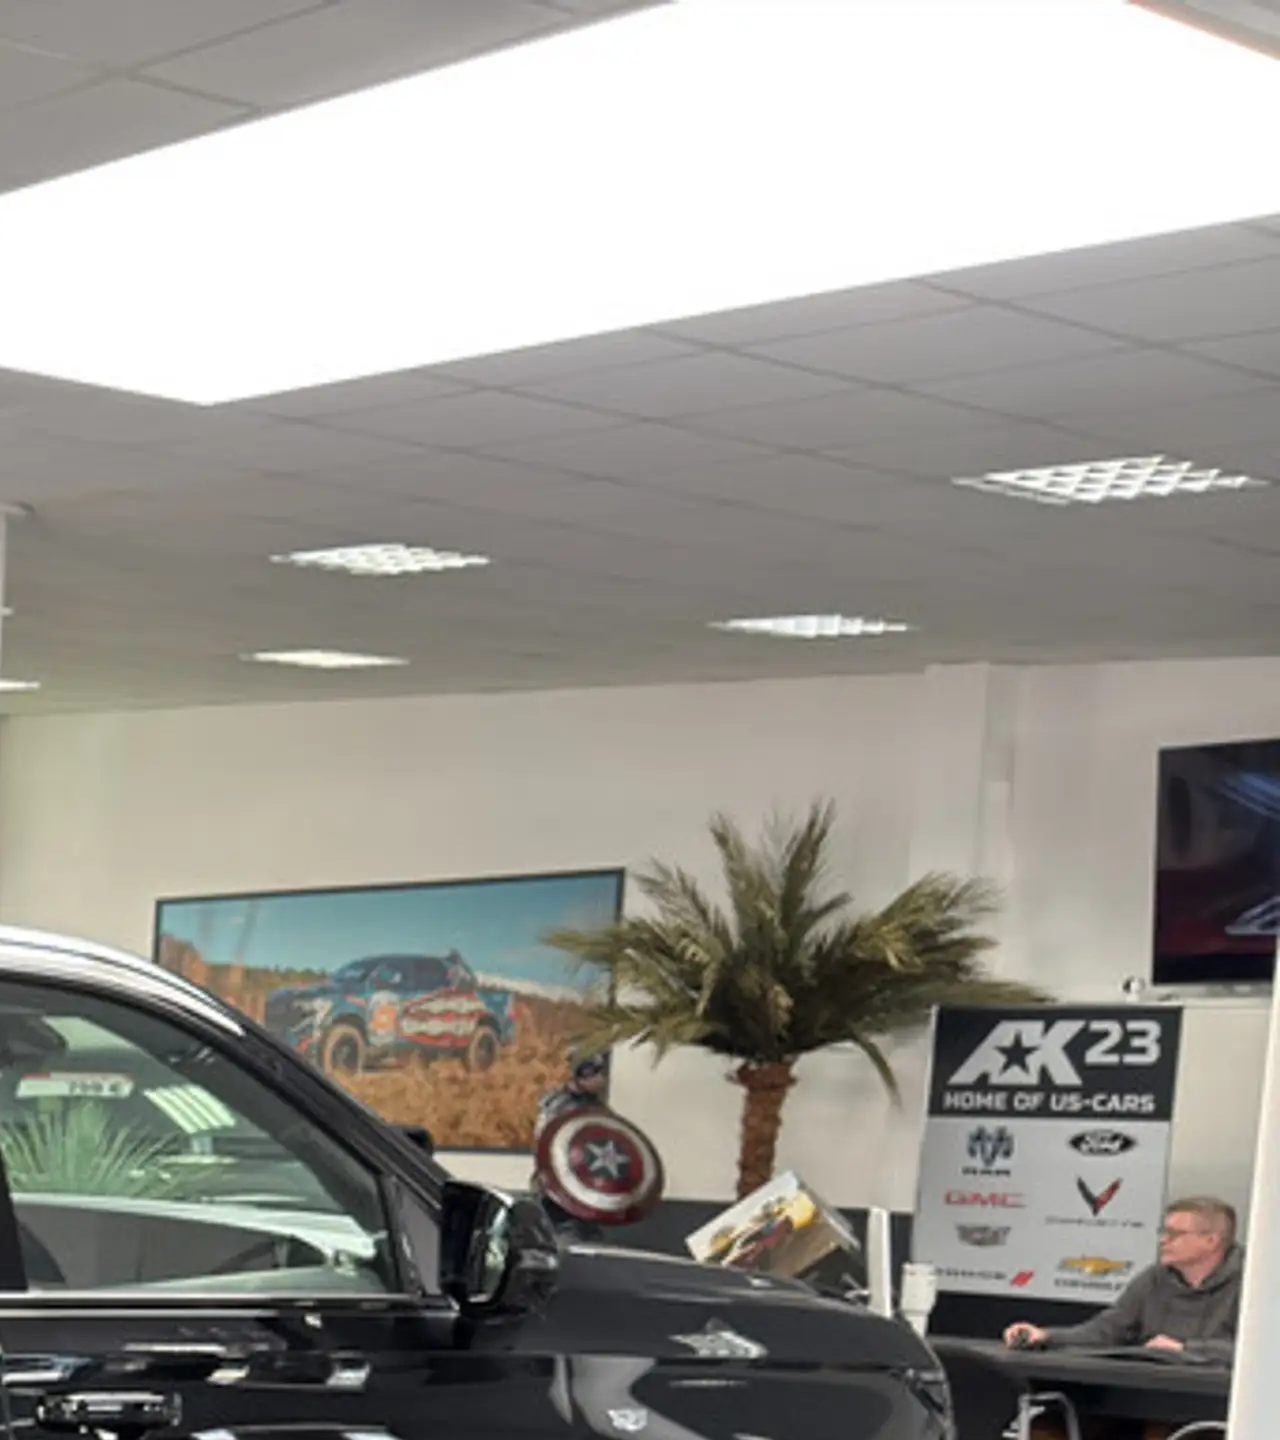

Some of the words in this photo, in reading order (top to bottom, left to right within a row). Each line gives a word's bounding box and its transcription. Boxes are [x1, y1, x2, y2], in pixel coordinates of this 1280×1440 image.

[943, 1090, 1007, 1111] HOME
[1013, 1091, 1044, 1112] OF
[1050, 1092, 1156, 1113] US-CARS
